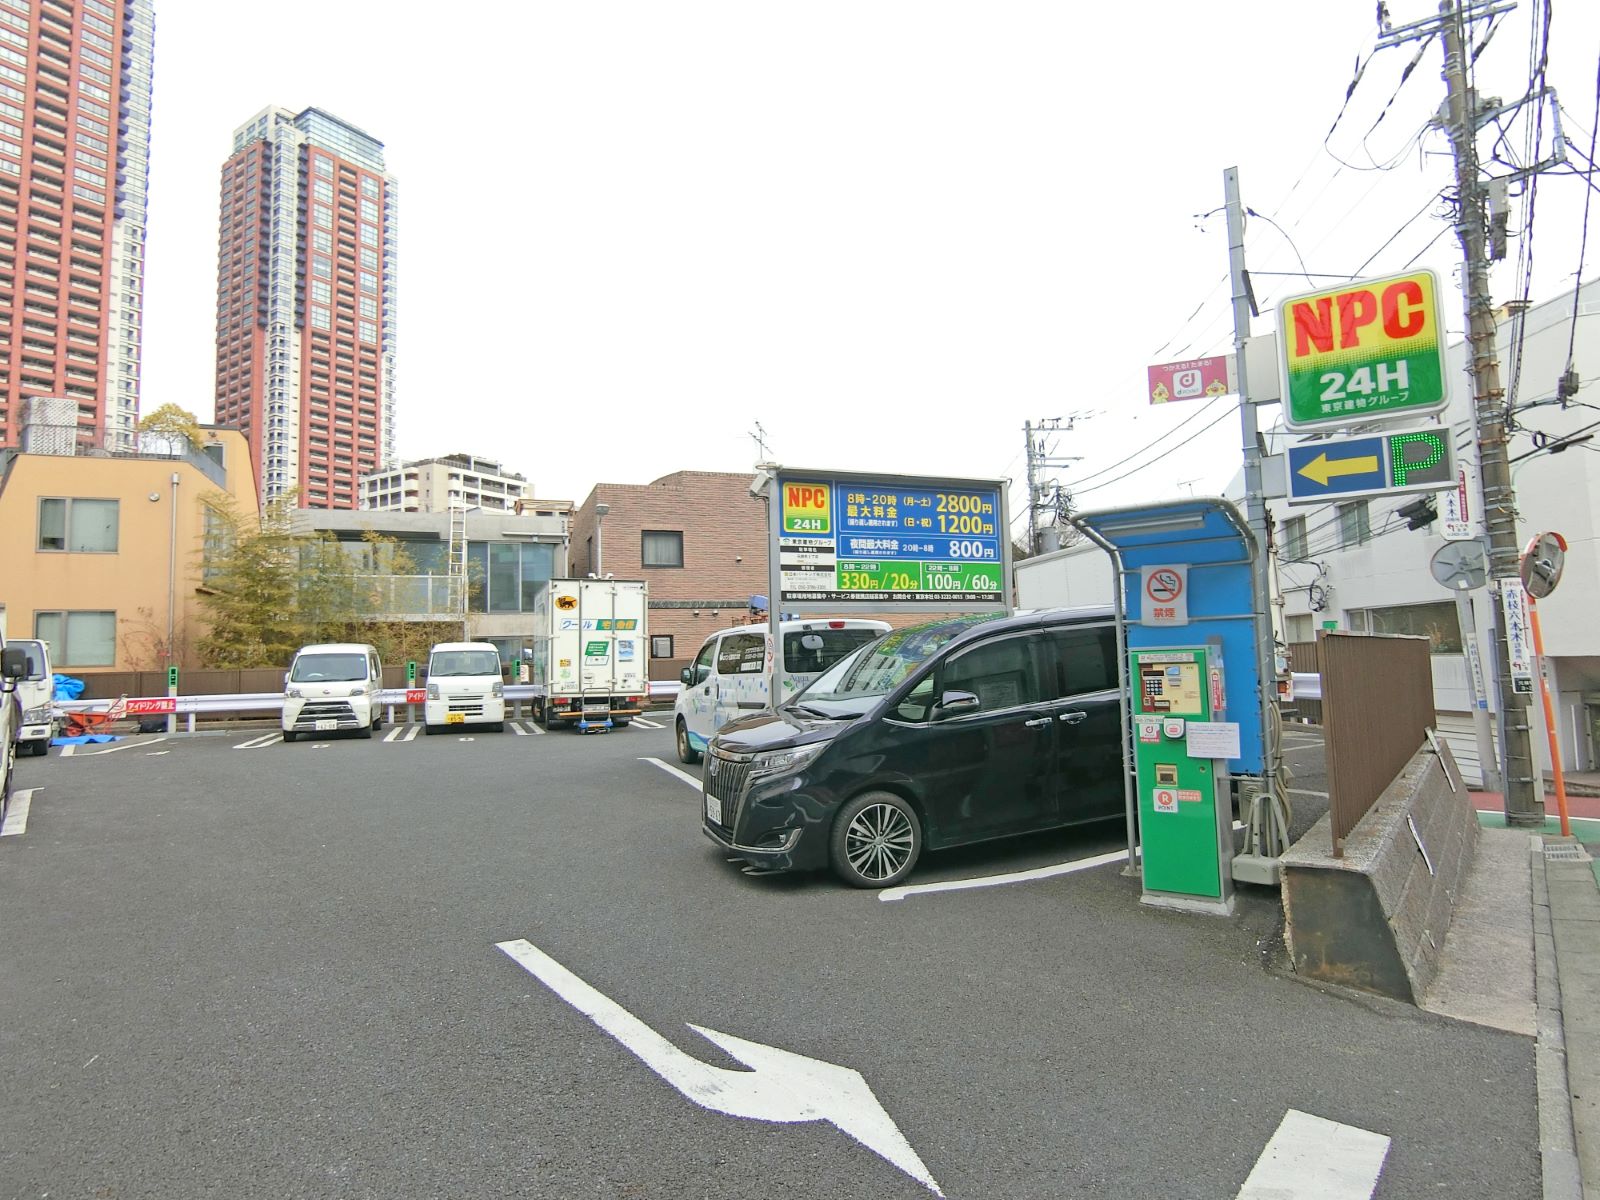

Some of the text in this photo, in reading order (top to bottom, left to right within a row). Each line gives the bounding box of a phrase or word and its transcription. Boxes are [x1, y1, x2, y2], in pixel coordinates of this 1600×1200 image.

[1292, 280, 1425, 357] NPC
[1320, 360, 1408, 402] 24H
[1321, 391, 1409, 414] 東京建物グループ
[1390, 432, 1445, 487] P
[788, 487, 825, 508] NPC
[936, 493, 992, 514] 2800円
[847, 505, 897, 518] 最大料金
[793, 519, 821, 530] 24H
[938, 514, 993, 534] 1200円
[850, 538, 899, 550] 夜間最大料金
[949, 540, 994, 558] 800円
[1153, 607, 1176, 618] 禁煙
